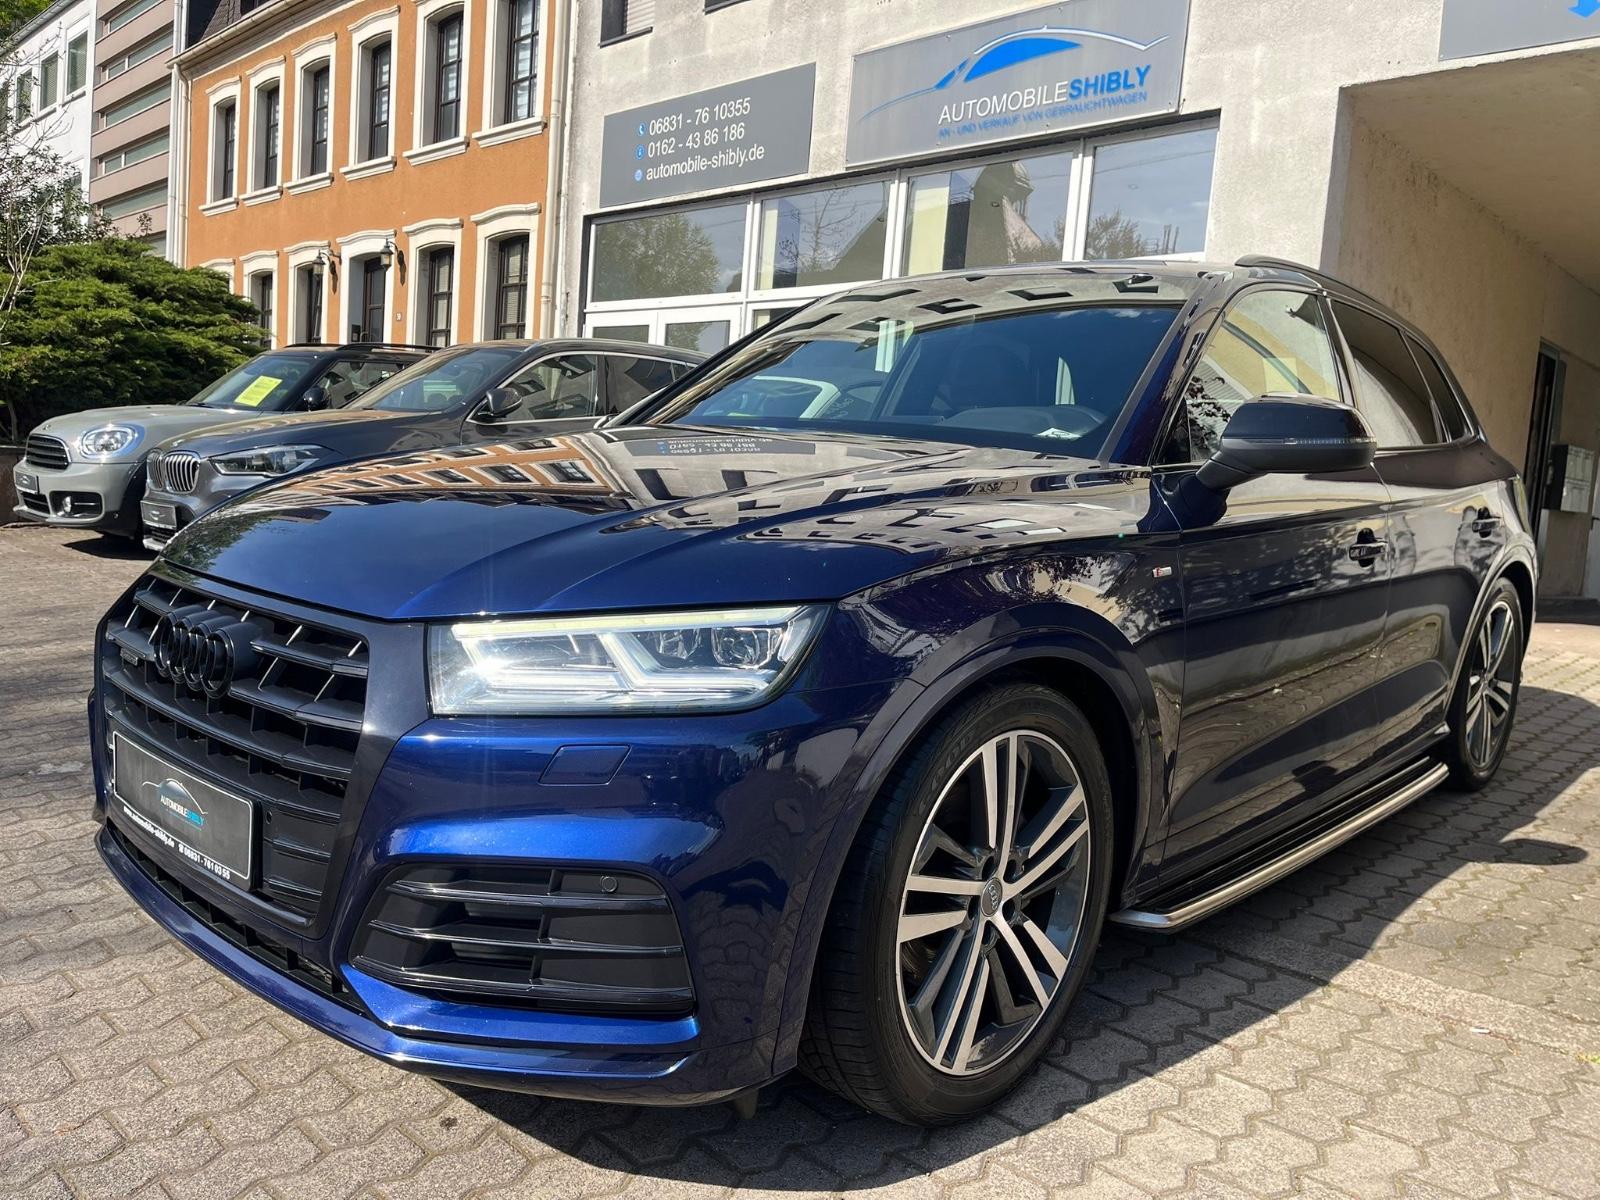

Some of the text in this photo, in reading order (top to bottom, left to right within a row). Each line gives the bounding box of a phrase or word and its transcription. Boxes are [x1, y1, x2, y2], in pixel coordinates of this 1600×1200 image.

[649, 112, 683, 136] 06831
[695, 107, 710, 126] 76
[713, 97, 751, 121] 10355
[648, 137, 676, 158] 0162
[686, 131, 701, 150] 43
[703, 127, 719, 146] 86
[722, 122, 745, 143] 186
[646, 143, 765, 181] automobile-shibly.de
